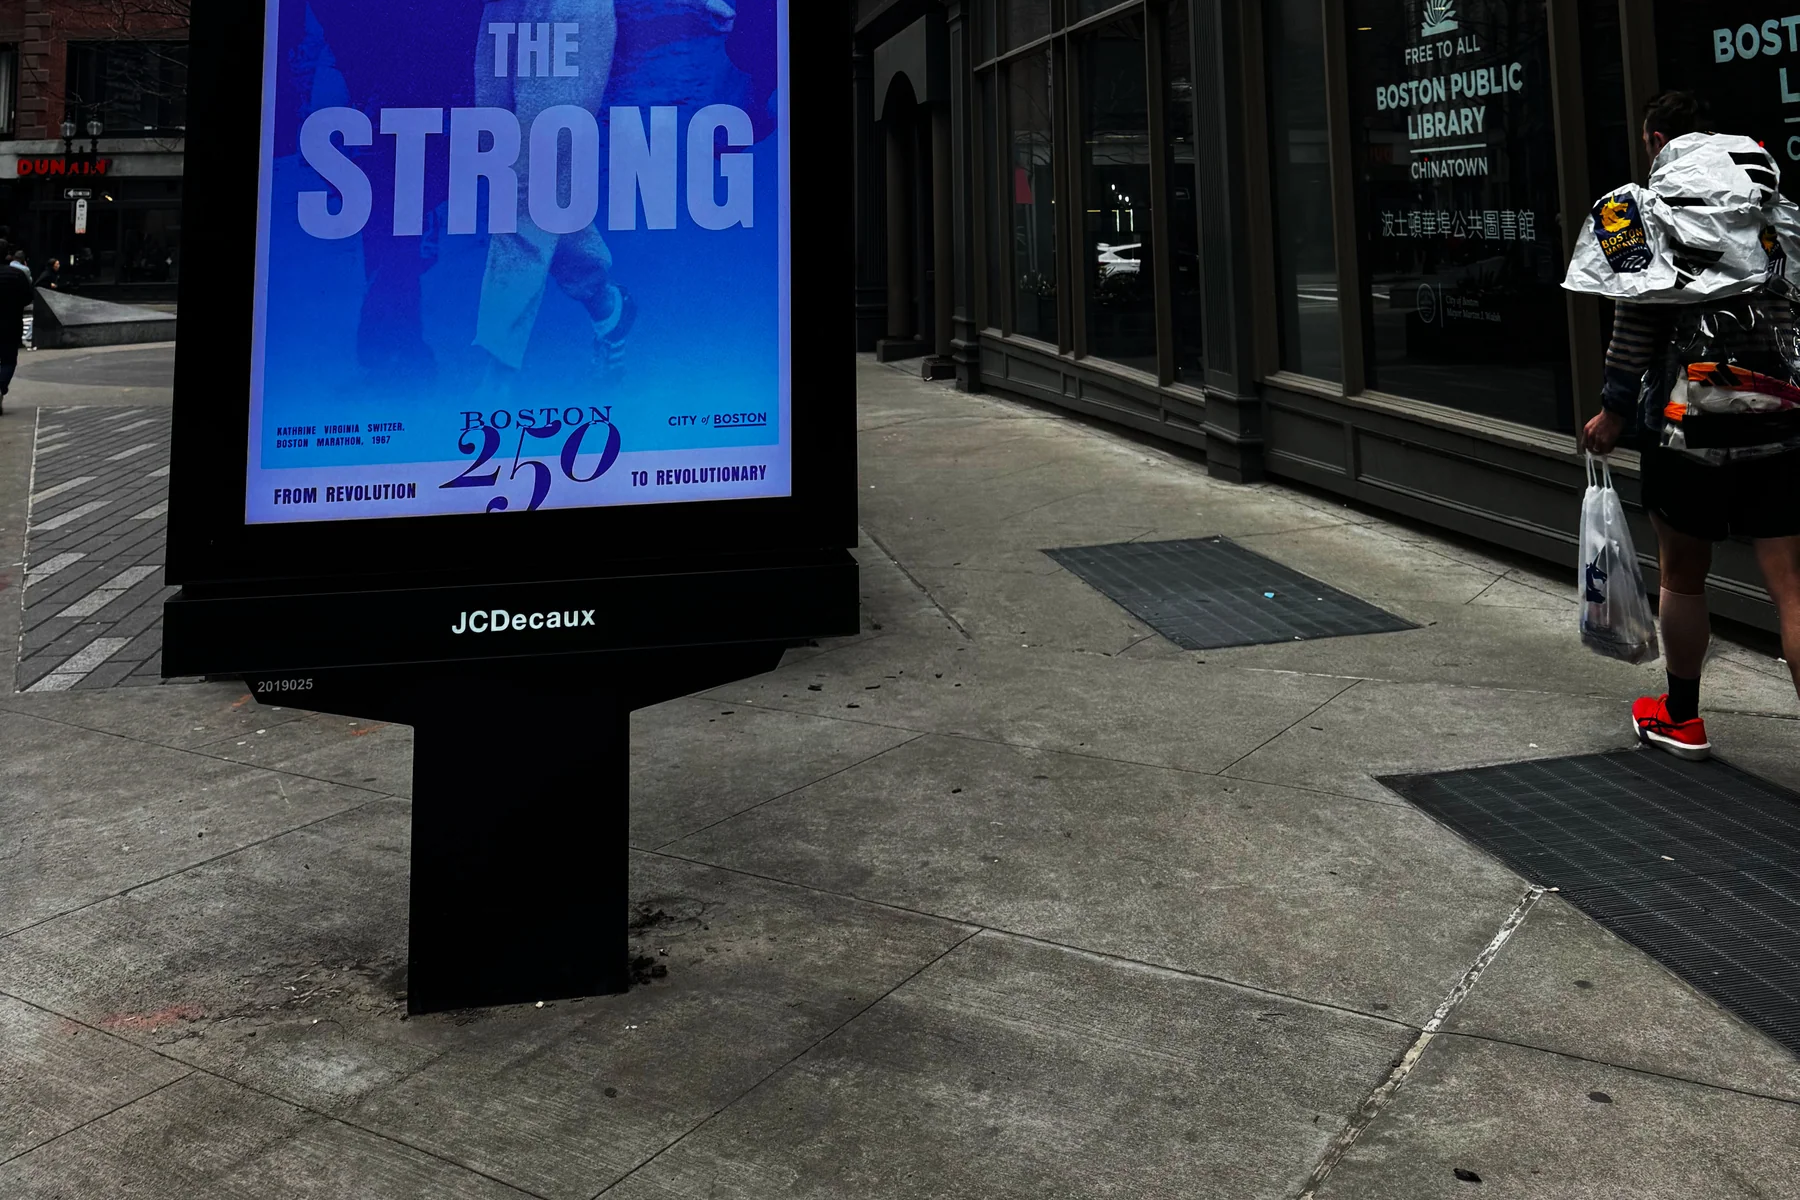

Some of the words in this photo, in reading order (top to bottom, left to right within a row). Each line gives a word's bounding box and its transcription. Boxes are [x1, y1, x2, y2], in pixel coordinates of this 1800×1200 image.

[488, 22, 580, 78] THE
[1405, 44, 1433, 66] FREE
[1436, 40, 1452, 59] TO
[1456, 34, 1481, 55] ALL
[1376, 76, 1446, 111] BOSTON
[1450, 61, 1523, 100] PUBLIC
[1407, 105, 1486, 141] LIBRARY
[297, 103, 755, 240] STRONG
[1411, 156, 1488, 179] CHINATOWN
[1381, 208, 1536, 242] 波士頓華埠公共圖書館
[1601, 227, 1643, 249] BOSTON
[277, 426, 316, 436] KATHRINE
[324, 424, 360, 434] VIRGINIA
[460, 406, 612, 431] BOSTON
[668, 415, 697, 426] CITY
[701, 415, 710, 425] of
[714, 412, 767, 424] BOSTON
[276, 439, 308, 448] BOSTON
[316, 436, 364, 447] MARATHON,
[372, 435, 391, 445] 1967
[439, 420, 621, 513] 250
[631, 471, 648, 487] TO
[656, 465, 767, 485] REVOLUTIONARY
[274, 487, 317, 504] FROM
[326, 483, 416, 502] REVOLUTION
[451, 609, 596, 634] JCDecaux
[257, 678, 314, 693] 2019025
